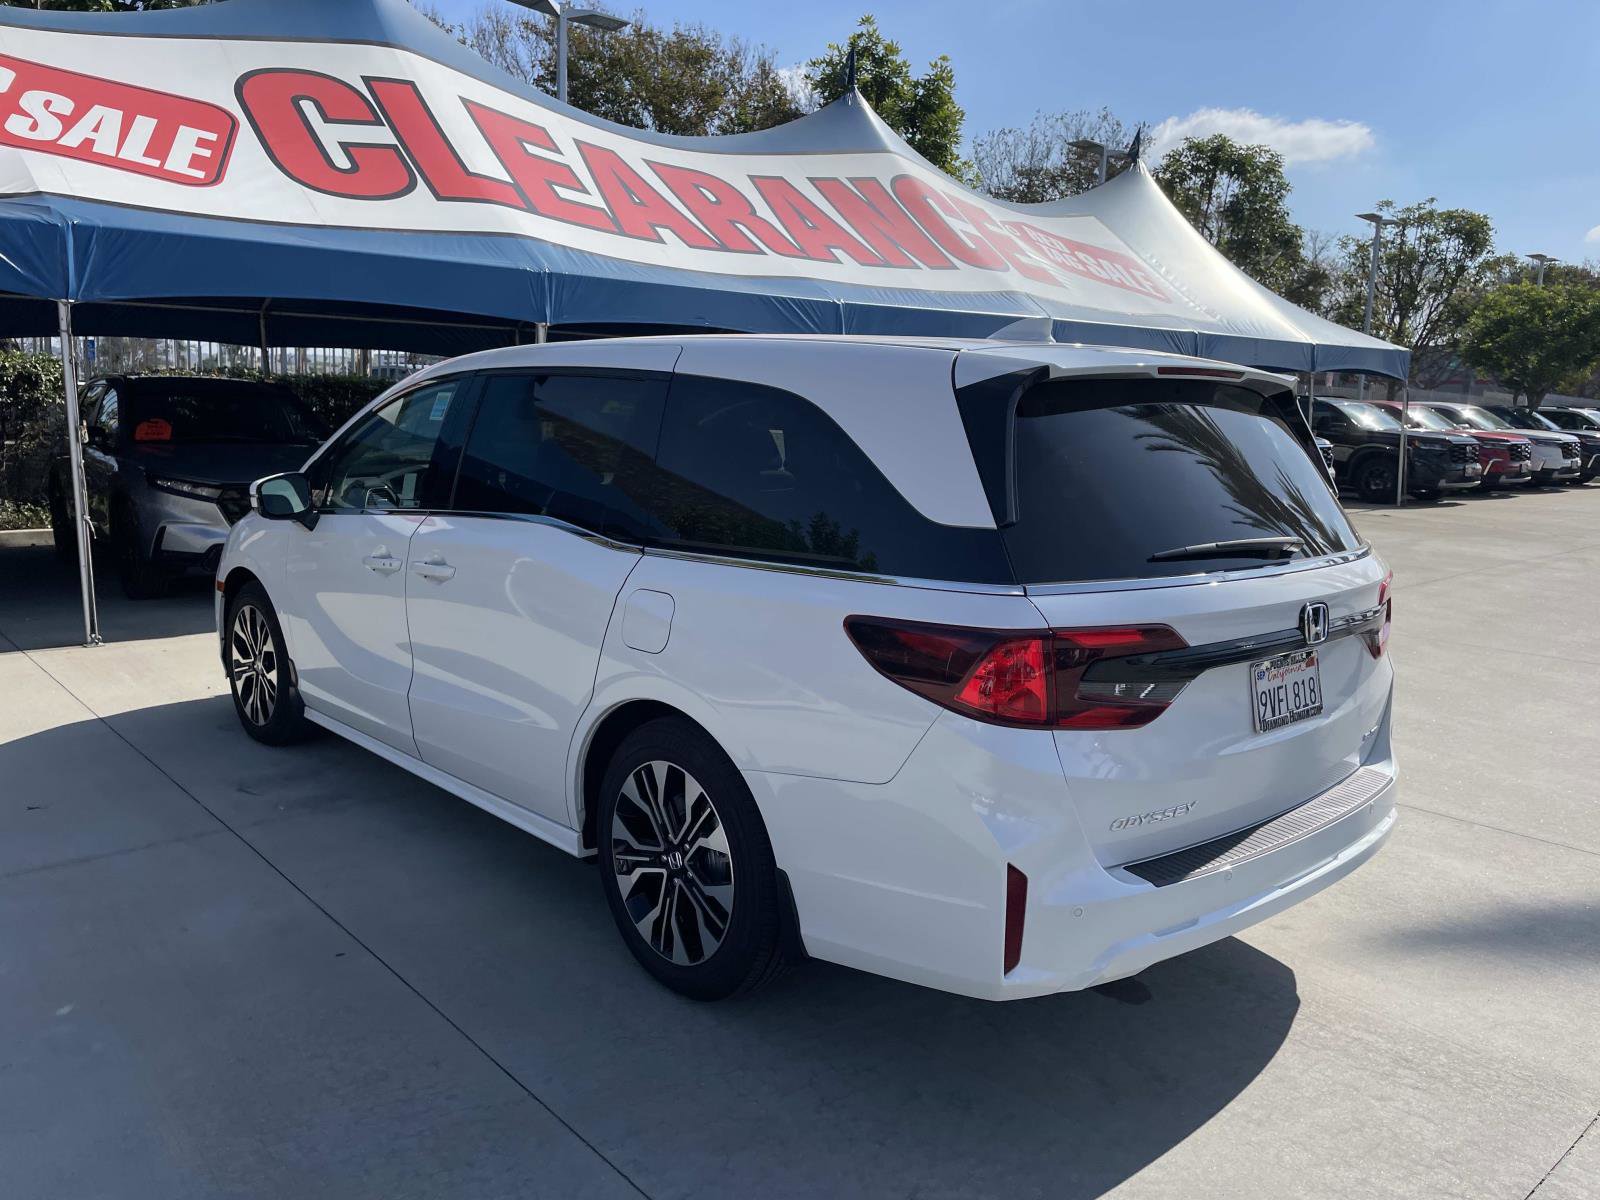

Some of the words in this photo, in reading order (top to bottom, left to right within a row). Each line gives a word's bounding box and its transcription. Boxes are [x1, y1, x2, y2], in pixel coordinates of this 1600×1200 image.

[4, 90, 218, 179] SALE
[233, 67, 1066, 291] CLEARANCE
[1074, 251, 1167, 300] SALE
[1260, 676, 1317, 719] 9VFL818
[1109, 800, 1198, 832] ODYSSEY
